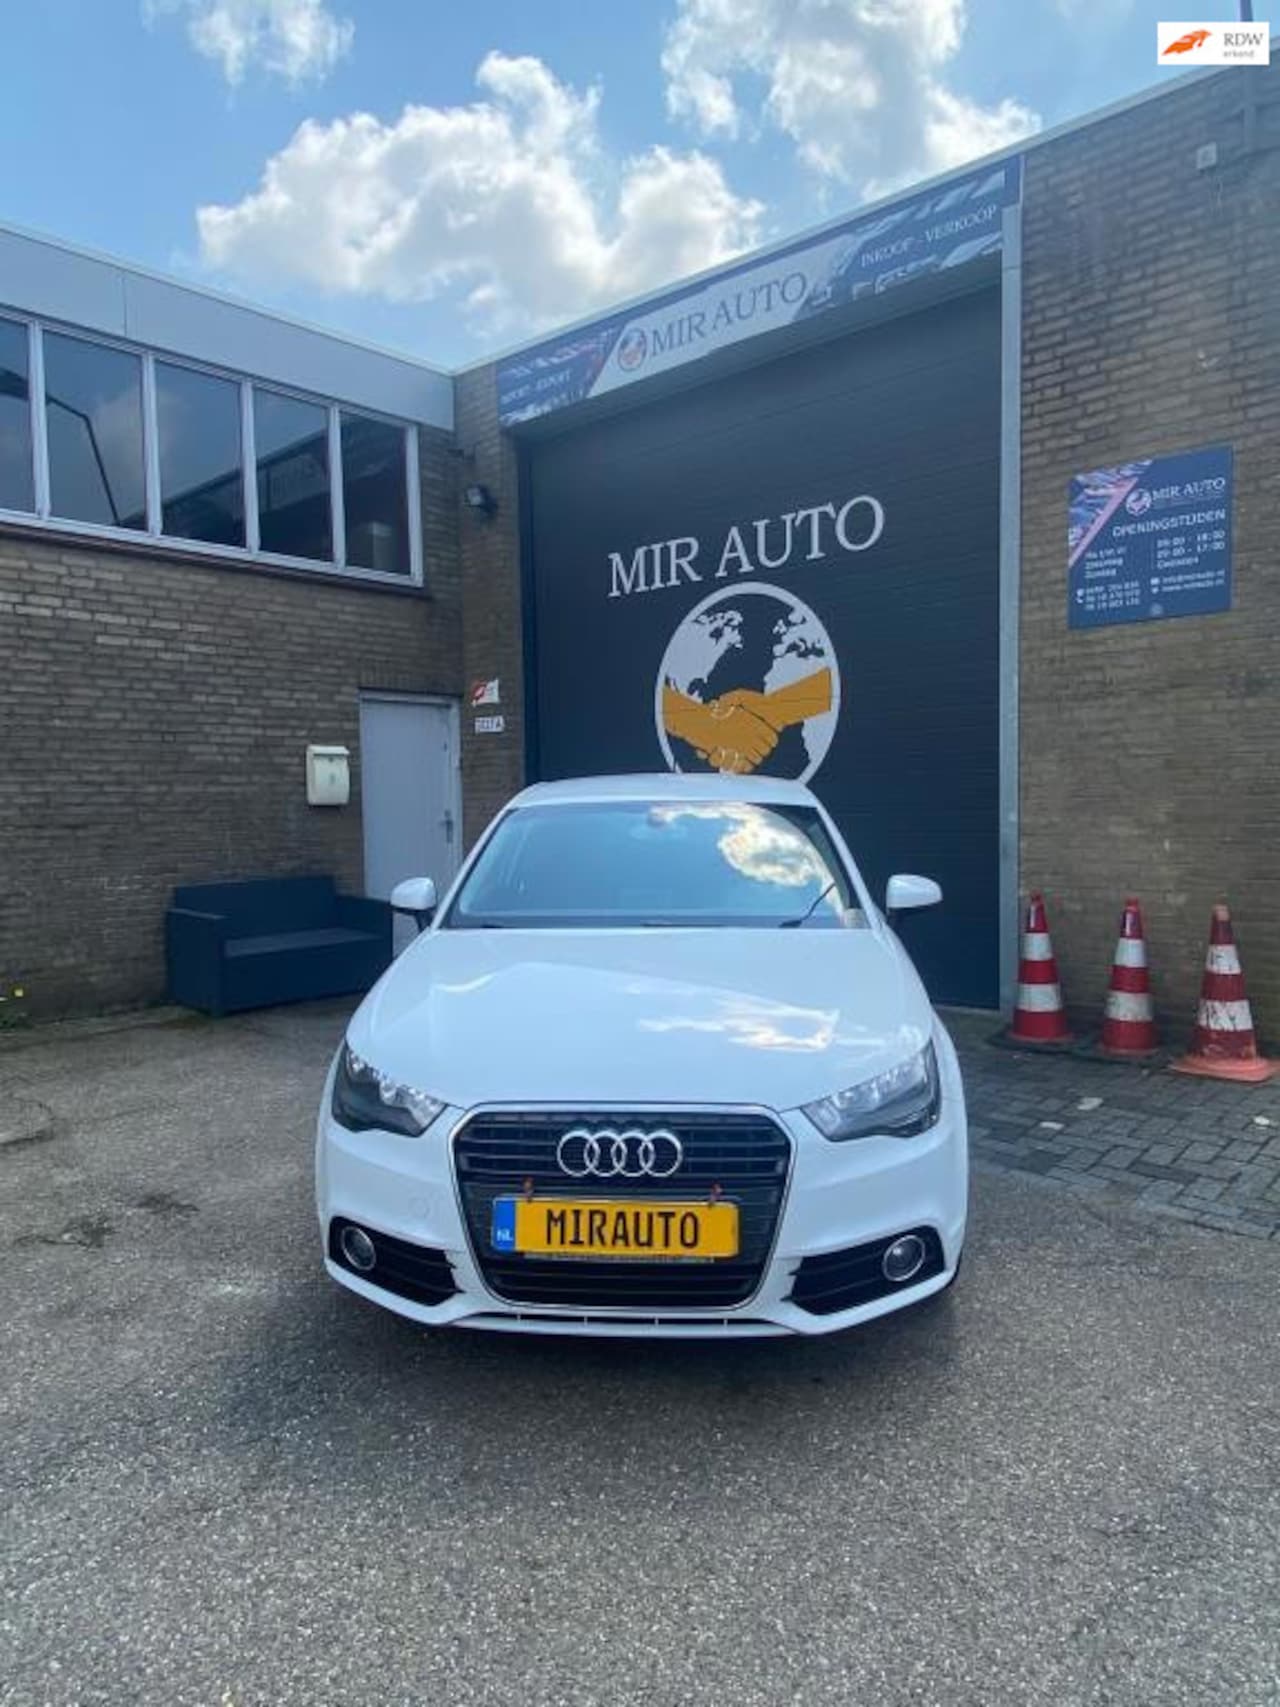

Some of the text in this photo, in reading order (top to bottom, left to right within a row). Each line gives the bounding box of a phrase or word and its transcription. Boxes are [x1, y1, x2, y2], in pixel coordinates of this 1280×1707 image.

[925, 203, 997, 242] VERKOOP
[652, 272, 807, 355] MIR AUTO
[1152, 477, 1226, 500] MIR AUTO
[608, 495, 885, 597] MIR AUTO
[497, 1230, 513, 1241] NL
[546, 1208, 699, 1248] MIRAUTO
